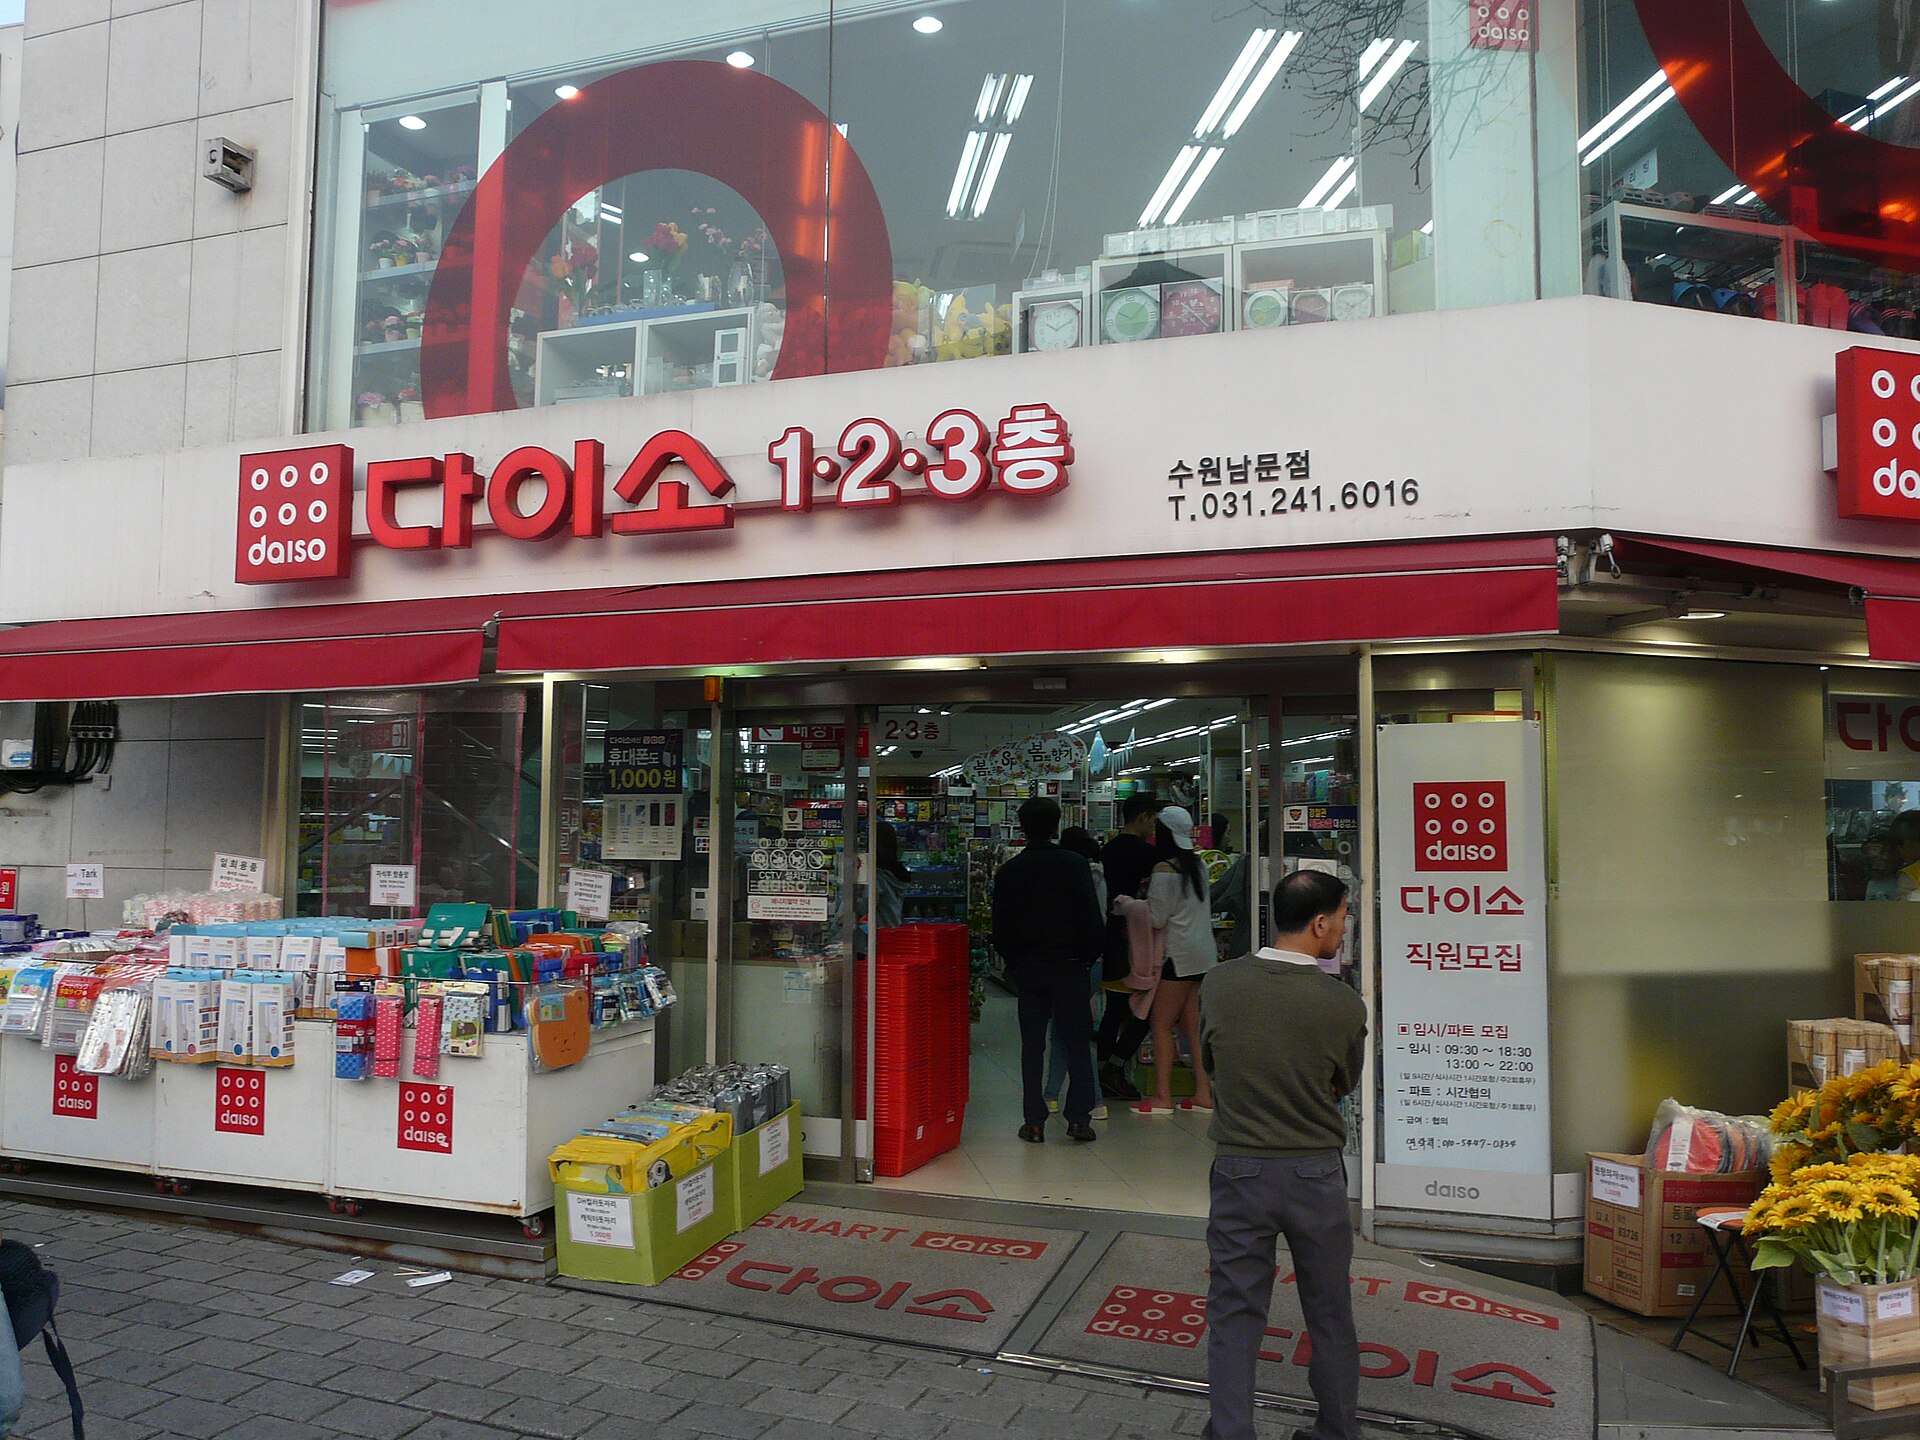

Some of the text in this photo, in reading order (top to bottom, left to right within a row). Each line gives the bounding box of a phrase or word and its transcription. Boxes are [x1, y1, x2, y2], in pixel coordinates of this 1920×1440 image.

[1478, 22, 1529, 41] daiso
[1167, 449, 1311, 489] 수원남문점
[366, 429, 737, 550] 다이소
[1167, 478, 1420, 521] T.031.241.6016
[247, 534, 327, 566] daiso
[608, 748, 660, 766] 휴대폰도
[1425, 840, 1496, 861] daiso
[1400, 885, 1525, 916] 다이소
[1405, 942, 1523, 973] 직원모집
[1413, 1022, 1509, 1039] 임시/파트 모집
[1409, 1043, 1532, 1057] 임시 09:30 18:30
[1446, 1059, 1534, 1072] 13:00 22:00
[58, 1094, 92, 1111] daiso
[1409, 1086, 1492, 1099] 파트 시간협의
[220, 1111, 259, 1127] daiso
[1406, 1116, 1422, 1125] 급여
[1424, 1181, 1480, 1200] daiso
[750, 1213, 910, 1243] SMART
[925, 1235, 1033, 1257] daiso
[725, 1259, 996, 1322] 다이소
[1418, 1289, 1546, 1325] daiso
[1091, 1319, 1197, 1344] daiso
